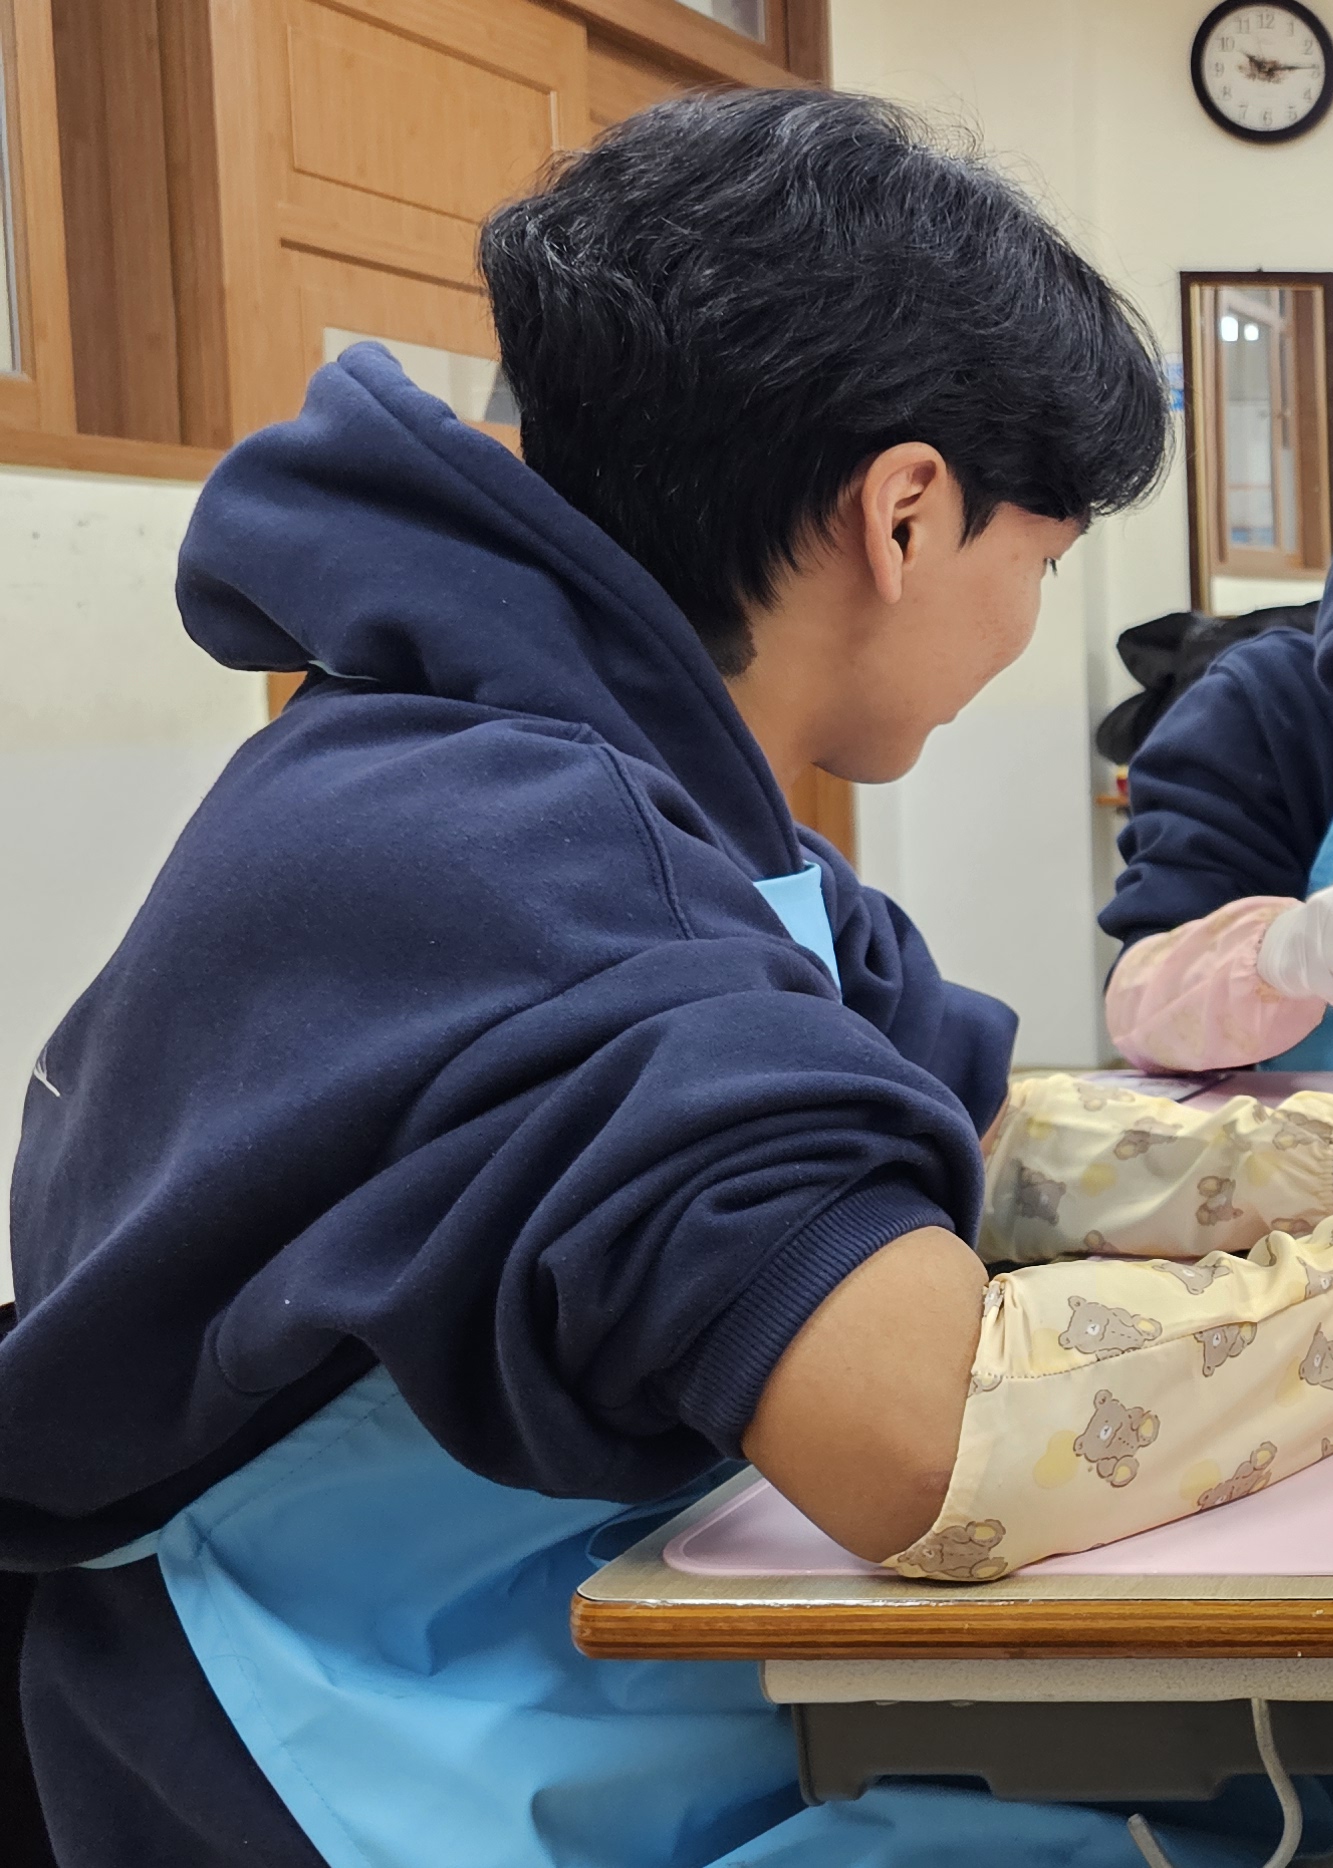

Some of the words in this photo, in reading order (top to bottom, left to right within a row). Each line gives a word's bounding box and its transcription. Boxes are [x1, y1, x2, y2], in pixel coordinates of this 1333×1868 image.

[1238, 19, 1250, 34] 11
[1258, 14, 1276, 29] 12
[1287, 21, 1295, 37] 1
[1220, 37, 1236, 52] 10
[1303, 39, 1314, 55] 2
[1215, 62, 1225, 77] 9
[1222, 86, 1232, 101] 8
[1303, 88, 1313, 102] 4
[1239, 104, 1249, 120] 7
[1263, 111, 1273, 126] 6
[1288, 106, 1297, 121] 5
